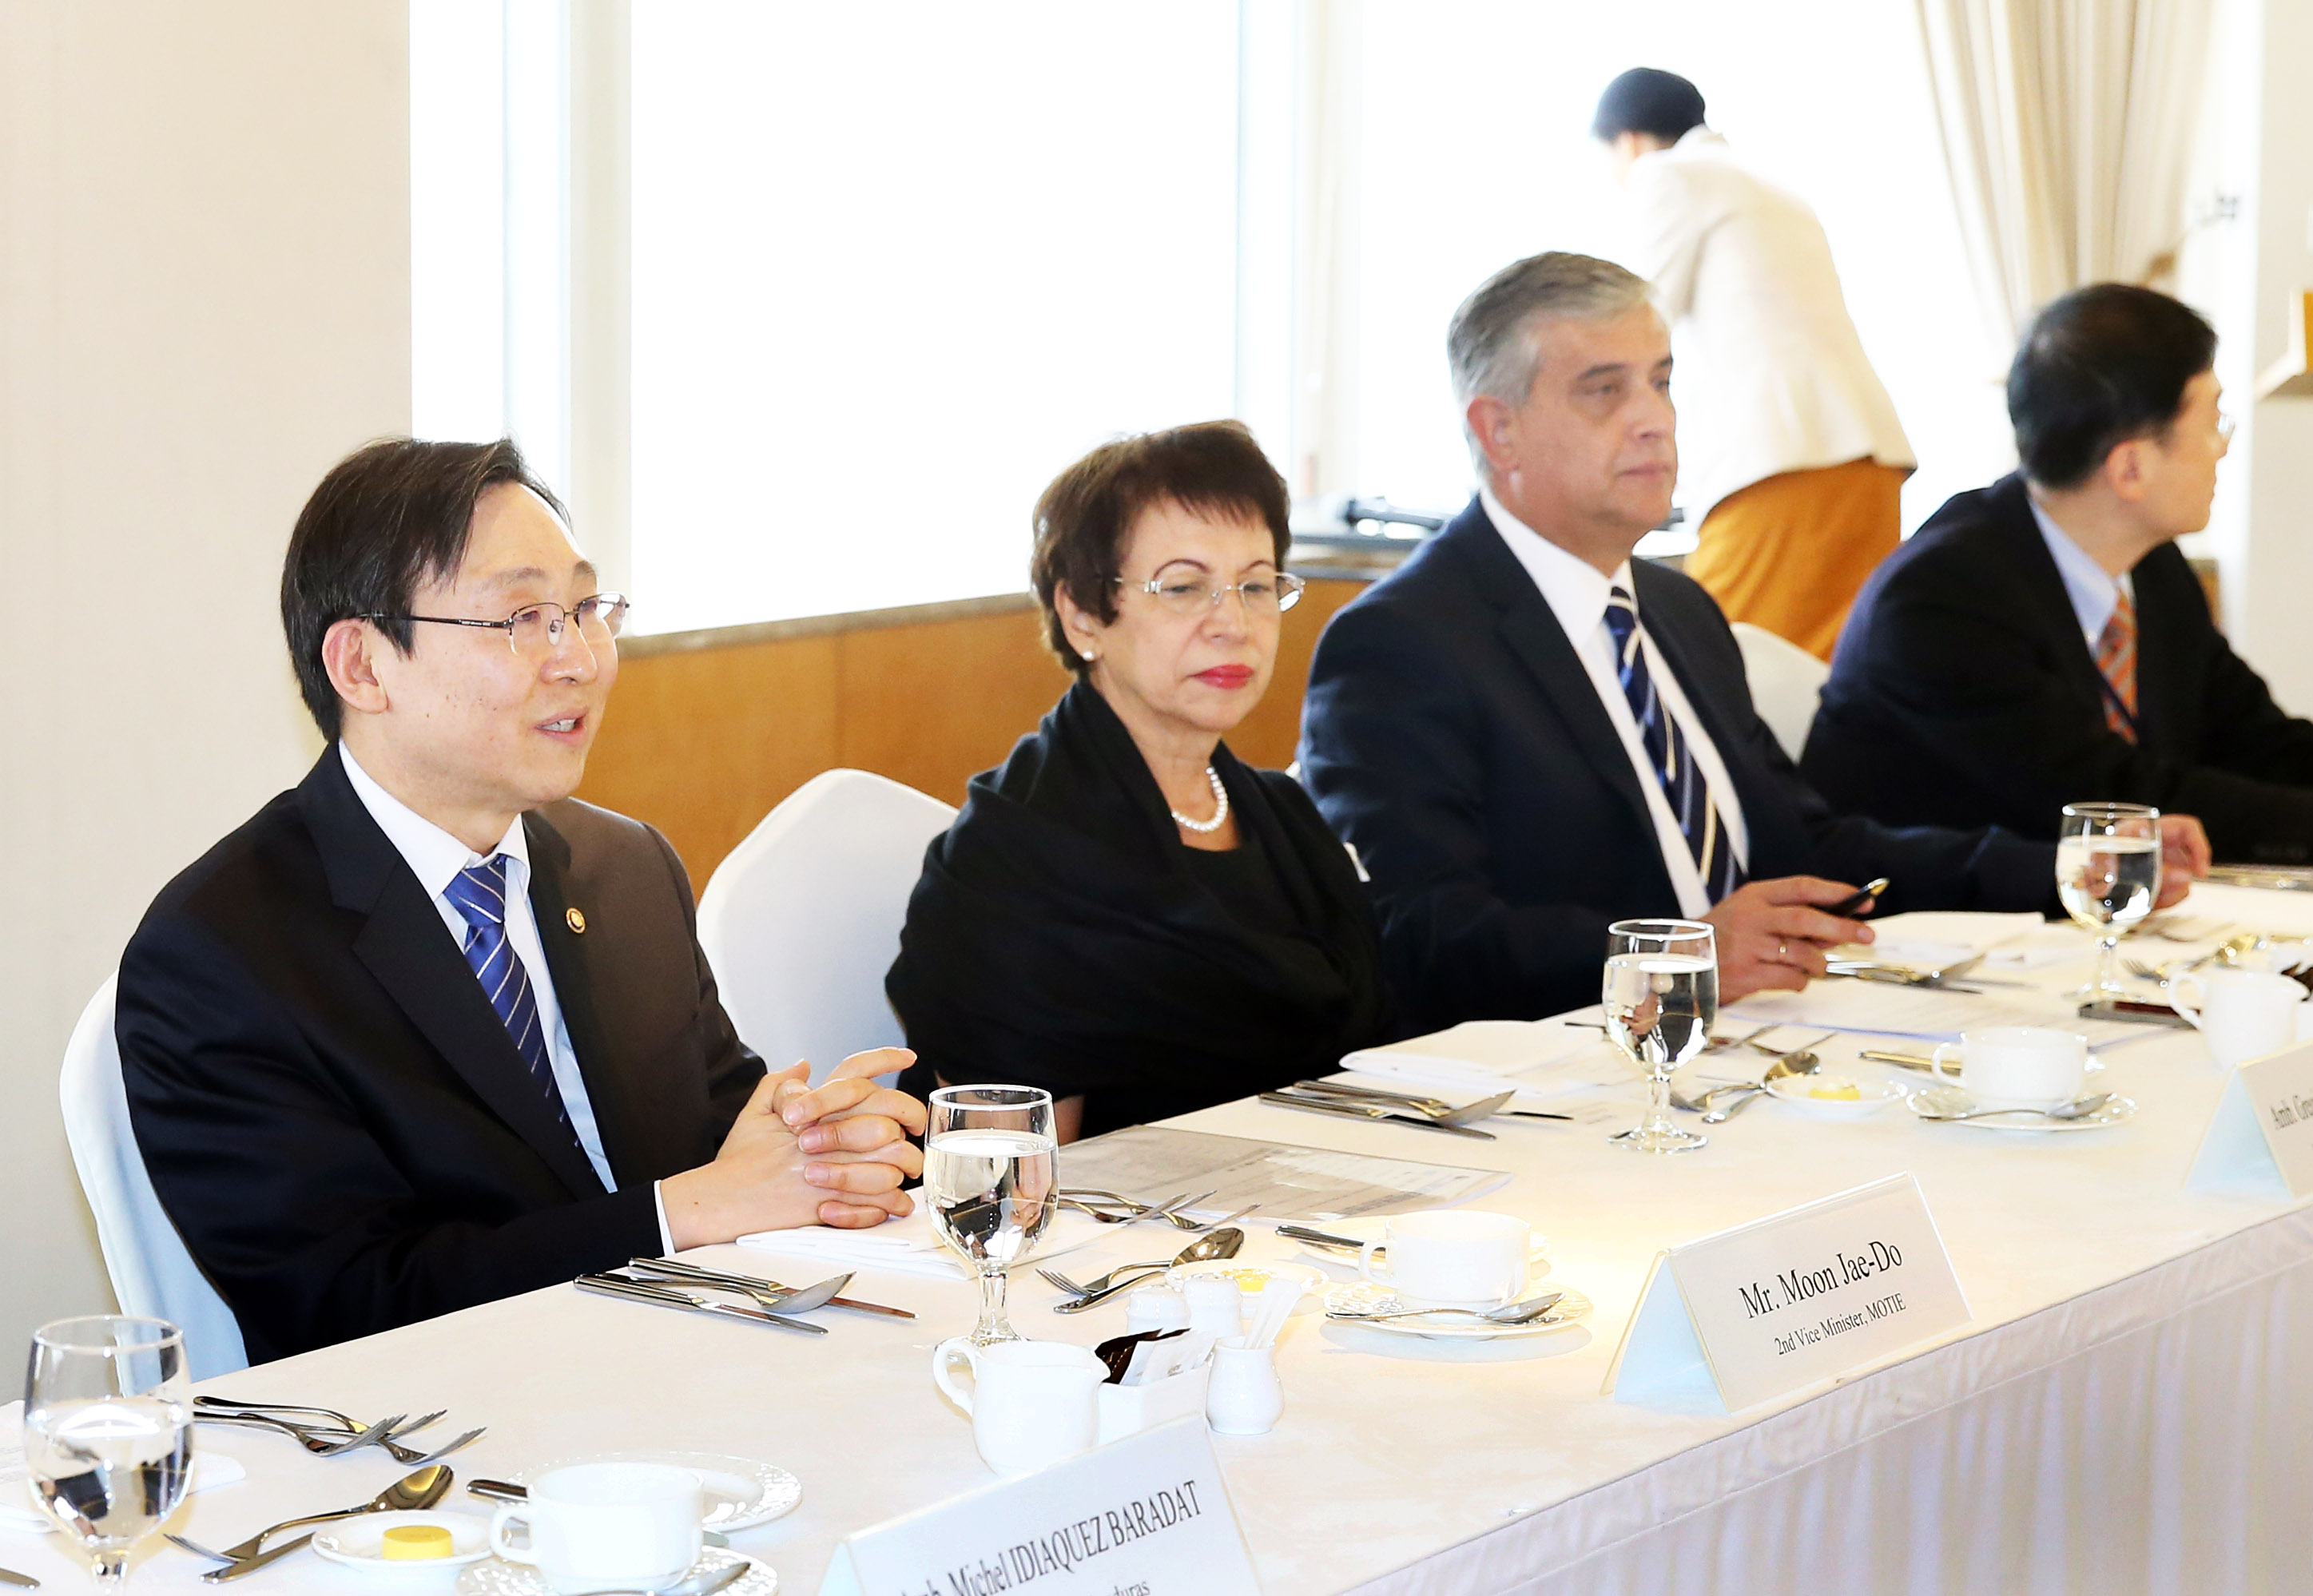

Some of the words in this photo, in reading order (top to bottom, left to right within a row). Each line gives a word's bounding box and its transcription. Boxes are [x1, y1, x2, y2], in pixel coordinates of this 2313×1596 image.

[1738, 1281, 1780, 1319] Mr.
[1775, 1268, 1839, 1305] Moon
[1835, 1241, 1903, 1284] Jae-Do
[1774, 1332, 1796, 1356] 2nd
[1794, 1326, 1822, 1347] Vice
[1819, 1313, 1869, 1338] Minister,
[1865, 1292, 1907, 1322] MOTIE
[948, 1551, 1013, 1596] Michel
[1008, 1515, 1110, 1584] IDIAQUEZ
[1104, 1479, 1202, 1547] BARADAT
